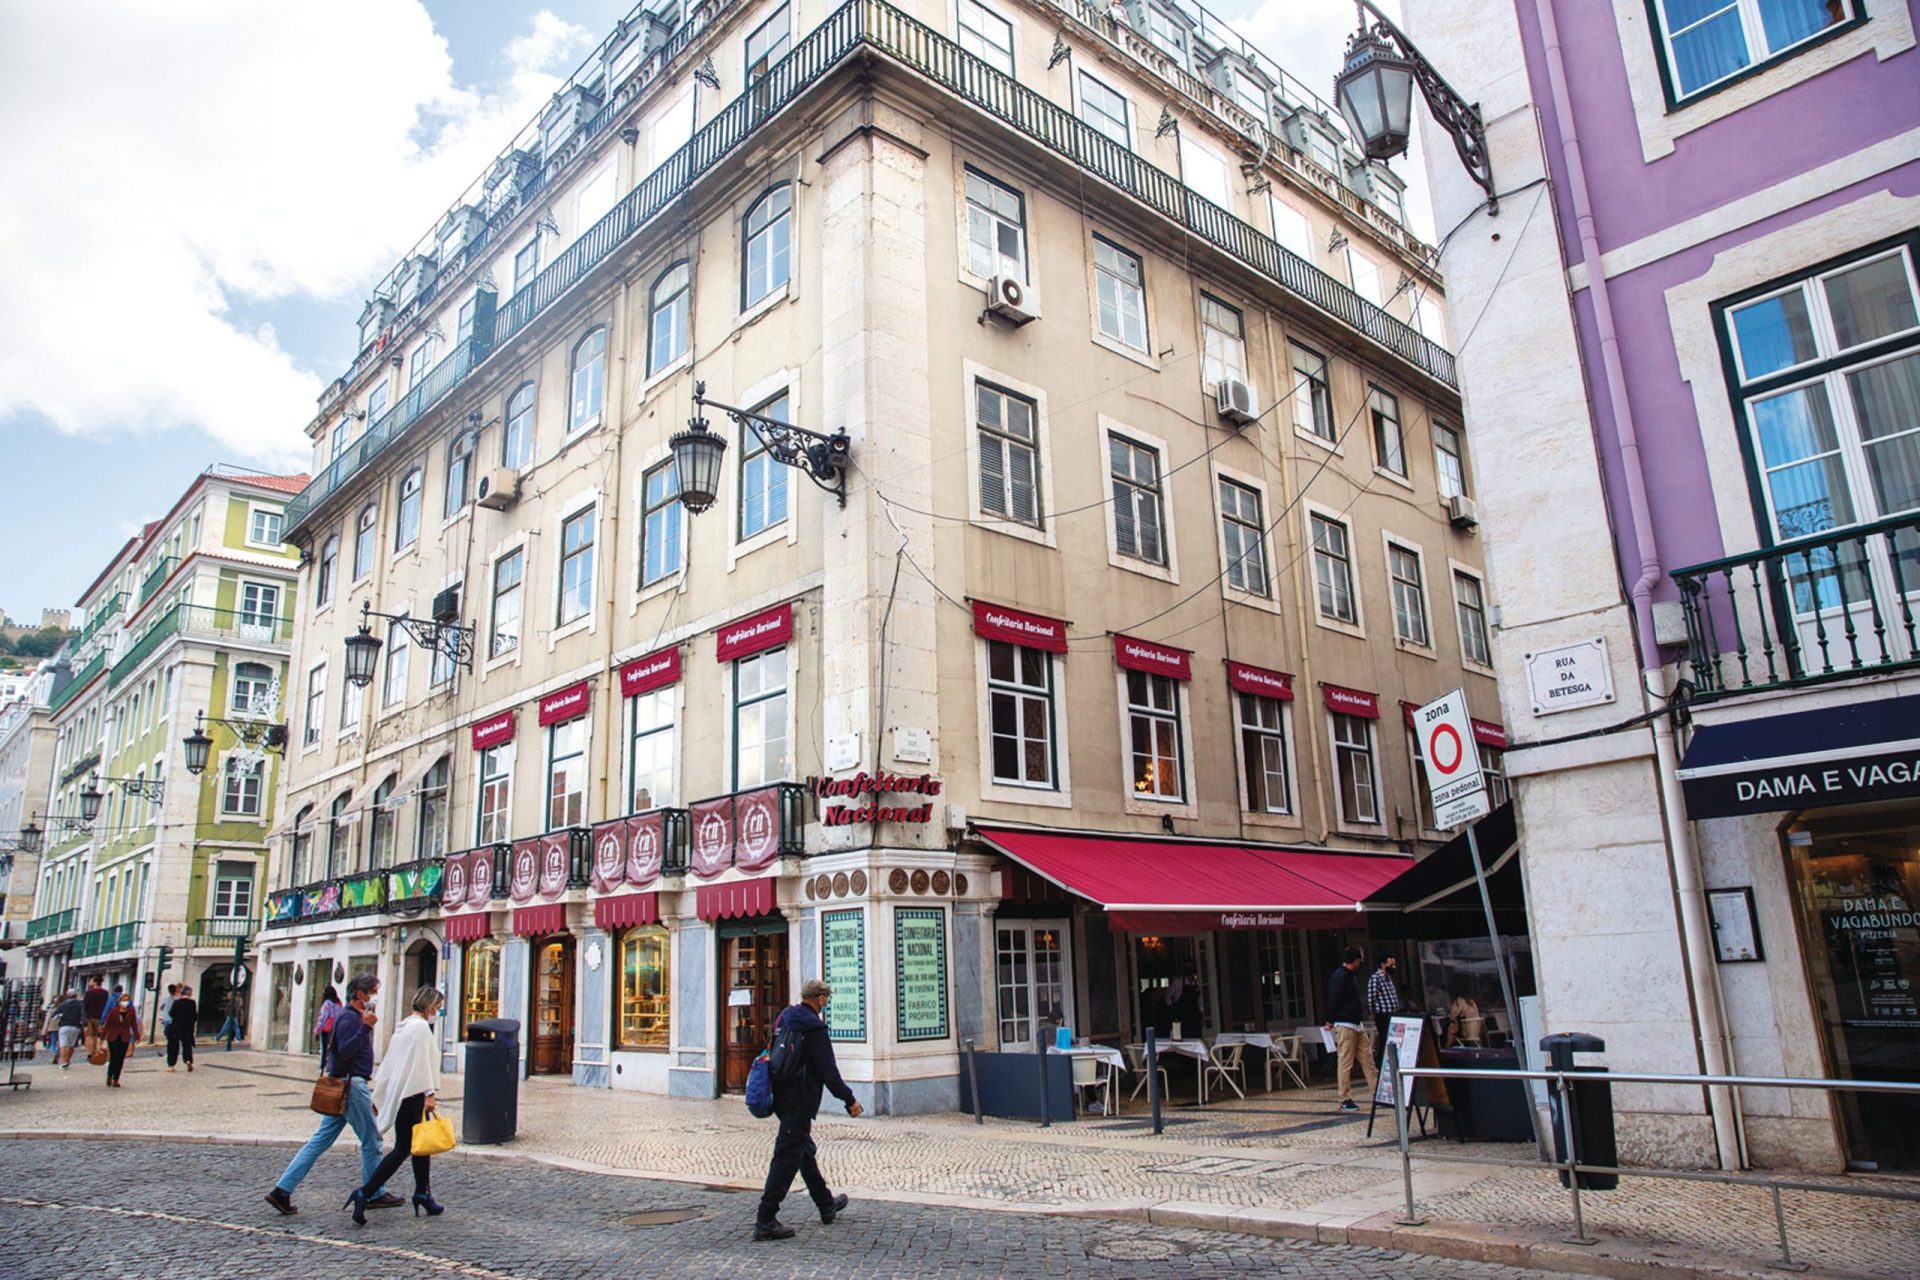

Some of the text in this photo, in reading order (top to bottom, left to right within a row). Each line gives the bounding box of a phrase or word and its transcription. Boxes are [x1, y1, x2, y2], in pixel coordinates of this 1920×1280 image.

[986, 612, 1054, 636] Confeitaria Nacional
[1556, 656, 1576, 668] RUA
[1560, 672, 1575, 680] DA
[1549, 683, 1592, 698] BETESGA
[1425, 702, 1450, 722] zona
[816, 771, 942, 798] Confeitaria
[1435, 776, 1480, 802] zona pedonal
[1736, 774, 1816, 801] DAMA
[1822, 770, 1842, 791] E
[823, 802, 934, 826] Nacional
[1843, 896, 1902, 912] DAMA E
[1222, 912, 1284, 928] Confeitaria Nacional
[904, 926, 935, 940] CONFEITARIA
[907, 943, 933, 956] NACIONAL
[834, 1001, 858, 1011] FABRICO
[908, 1000, 936, 1010] FABRICO
